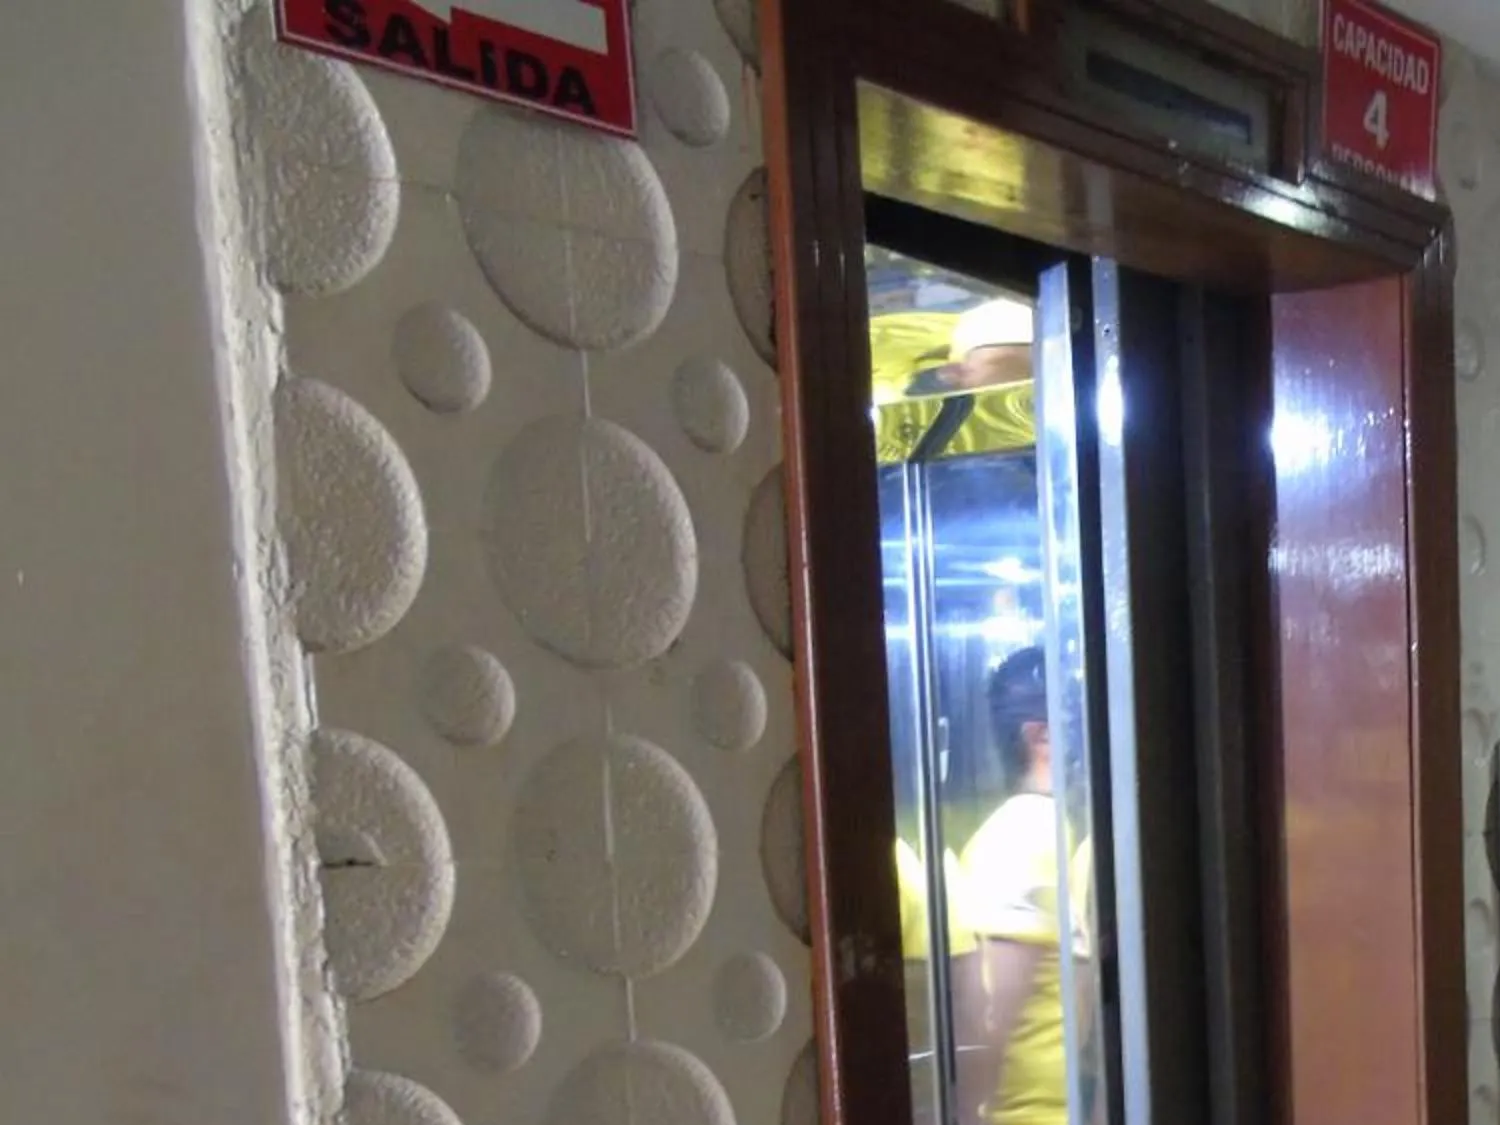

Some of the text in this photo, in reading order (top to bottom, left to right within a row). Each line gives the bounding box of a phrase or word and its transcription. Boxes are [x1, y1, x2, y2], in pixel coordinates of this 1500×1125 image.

[322, 0, 597, 115] SALIDA
[1332, 13, 1430, 96] CAPACIDAD
[1362, 90, 1390, 150] 4
